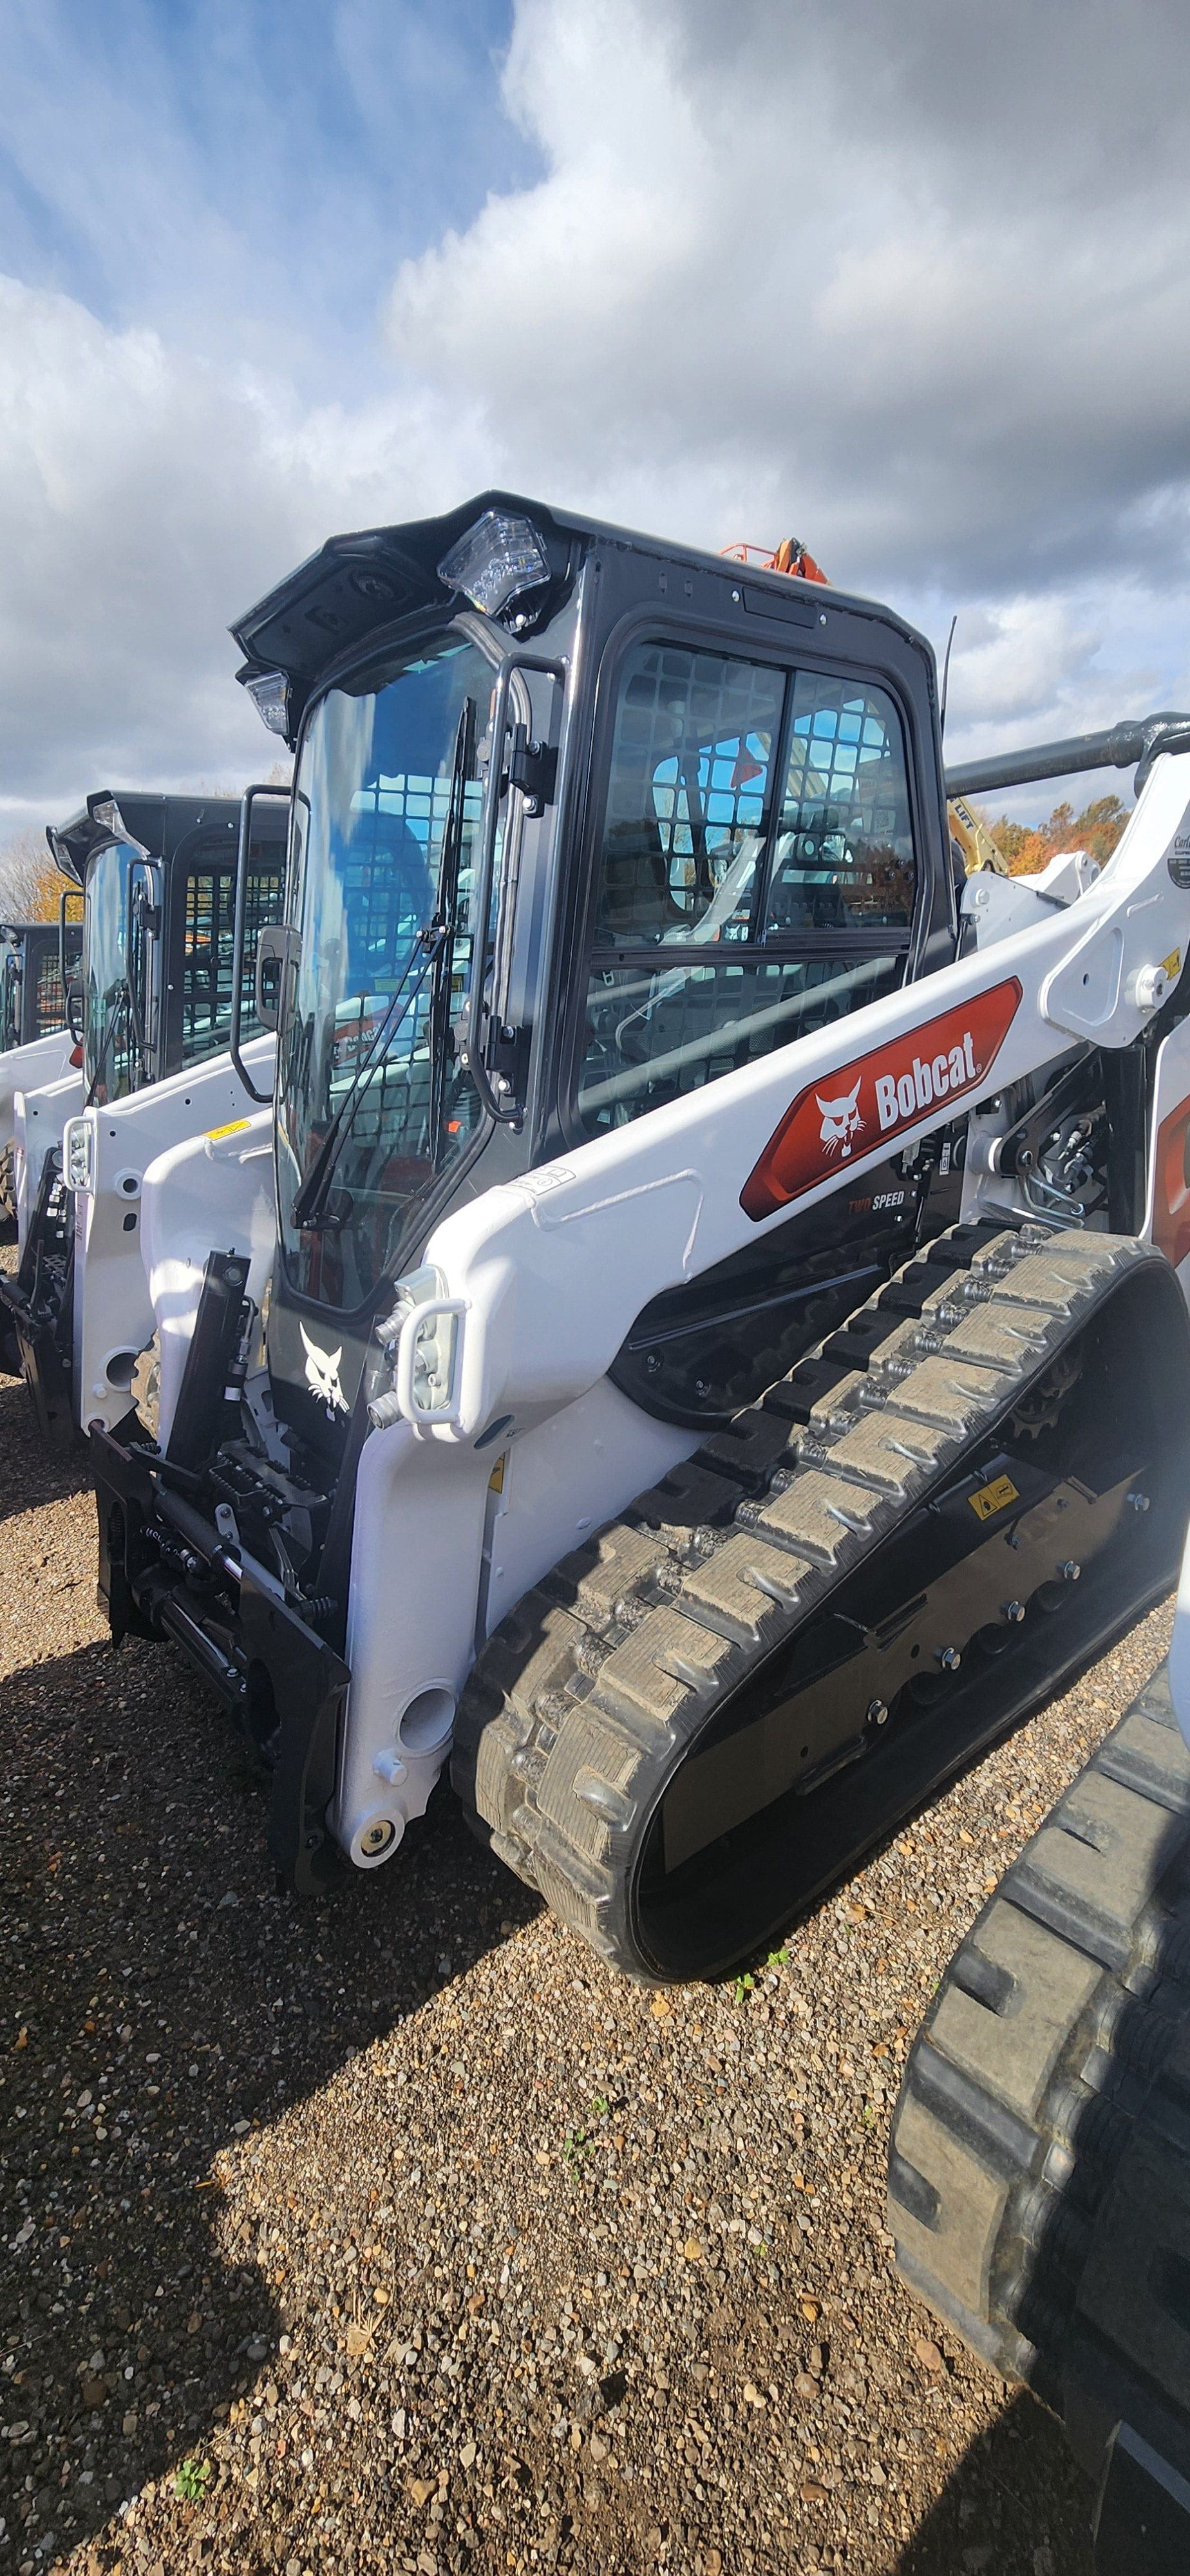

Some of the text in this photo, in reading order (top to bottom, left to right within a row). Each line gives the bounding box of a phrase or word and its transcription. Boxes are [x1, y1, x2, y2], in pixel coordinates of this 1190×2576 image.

[955, 804, 974, 829] LIFT
[849, 1191, 905, 1213] TWO SPEED
